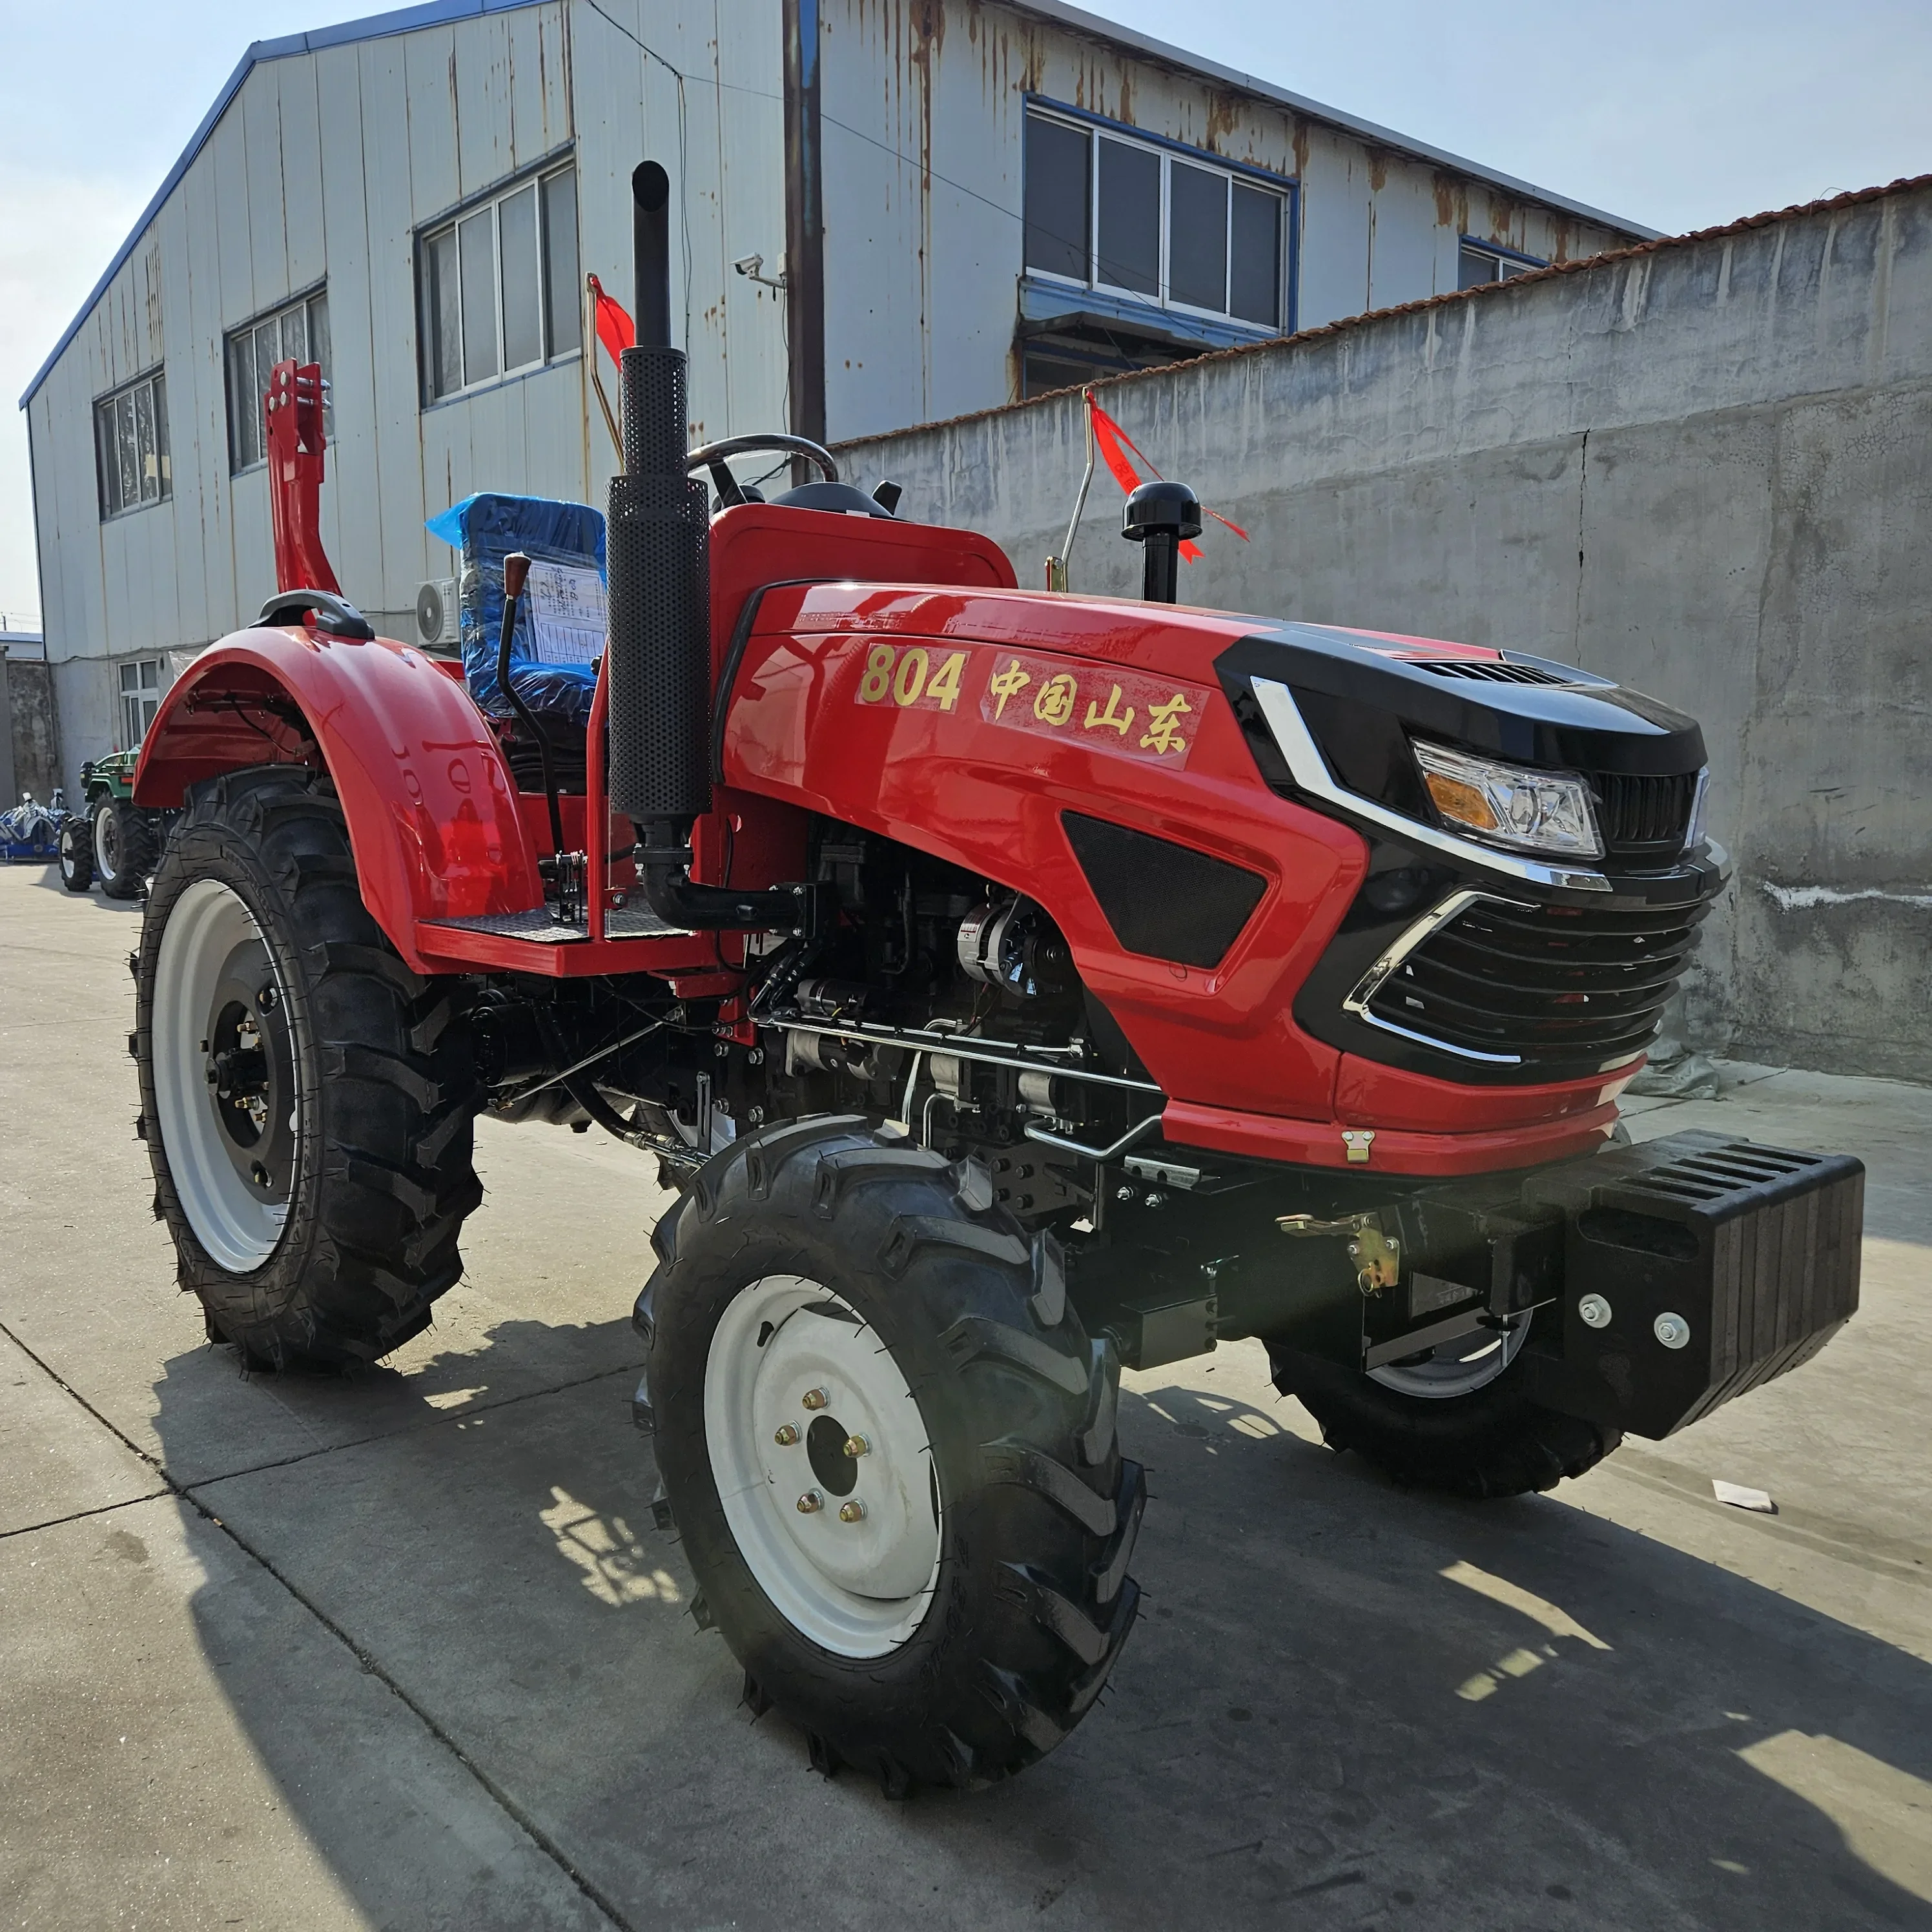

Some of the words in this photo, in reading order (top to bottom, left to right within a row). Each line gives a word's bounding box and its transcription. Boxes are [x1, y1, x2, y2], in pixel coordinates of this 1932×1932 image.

[861, 646, 967, 710] 804
[991, 660, 1192, 754] 中国山东
